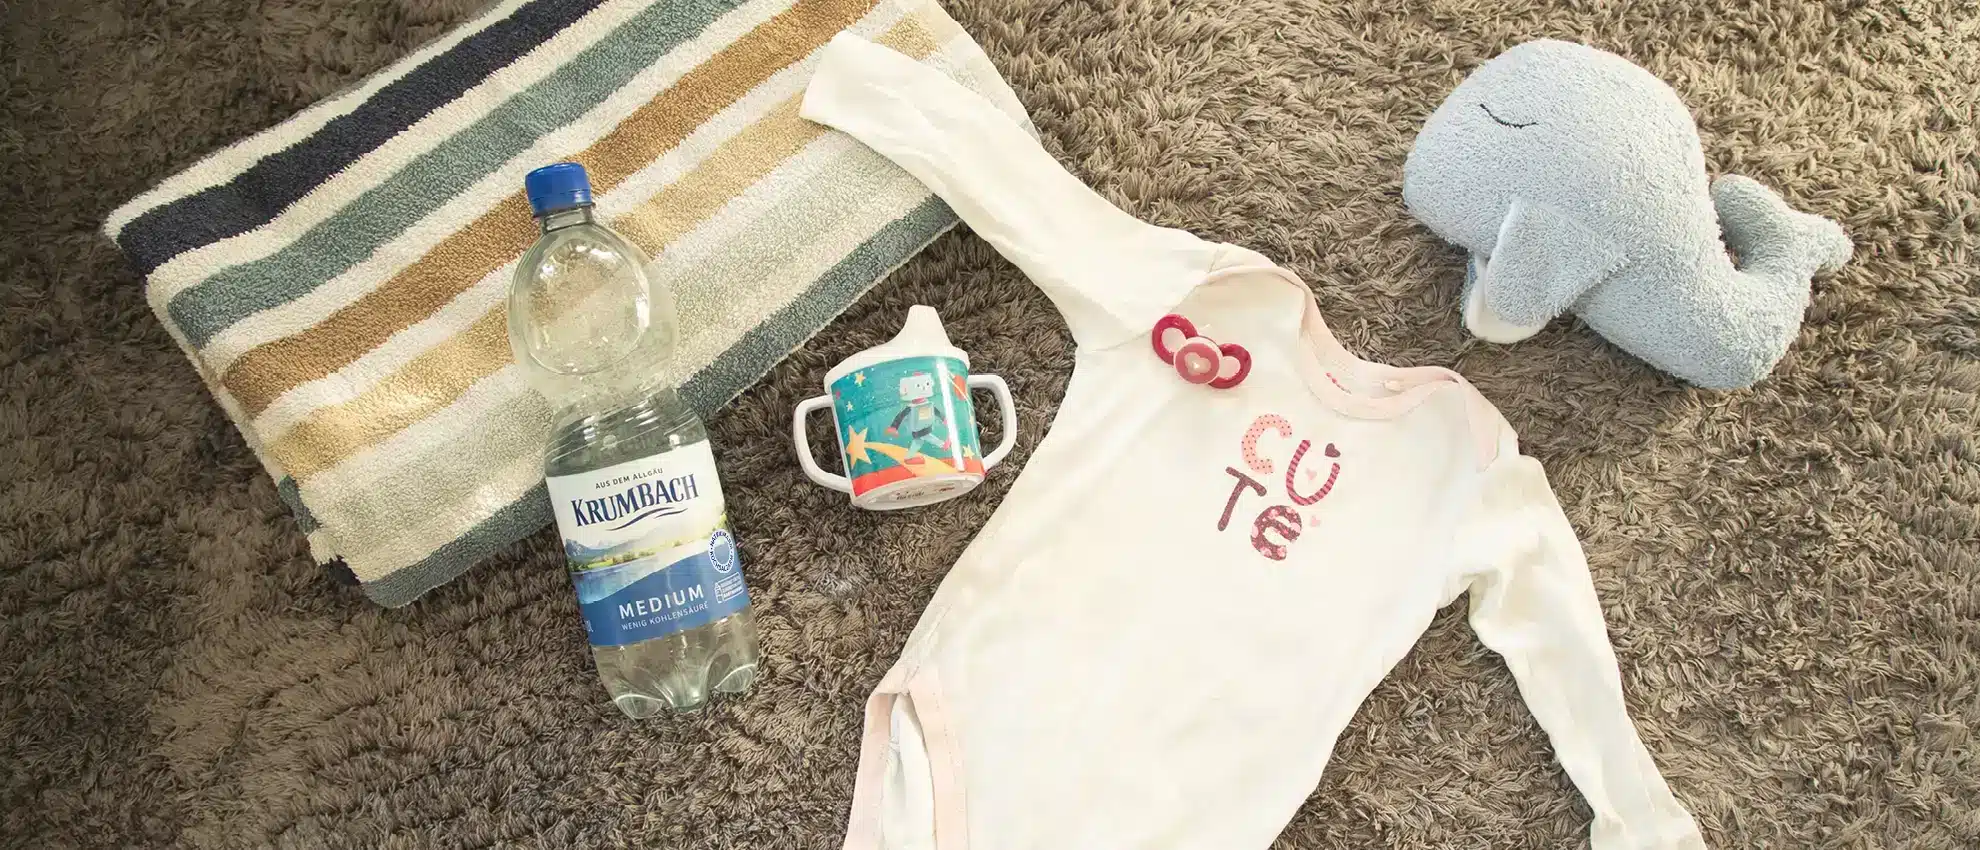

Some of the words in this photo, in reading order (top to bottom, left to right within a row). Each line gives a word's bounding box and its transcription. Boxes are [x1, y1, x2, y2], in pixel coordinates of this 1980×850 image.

[595, 481, 611, 489] AUS
[613, 476, 630, 485] DEM
[632, 467, 663, 480] ALLGÄU
[571, 473, 699, 527] KRUMBACH
[618, 584, 704, 619] MEDIUM
[621, 619, 647, 630] WENIG
